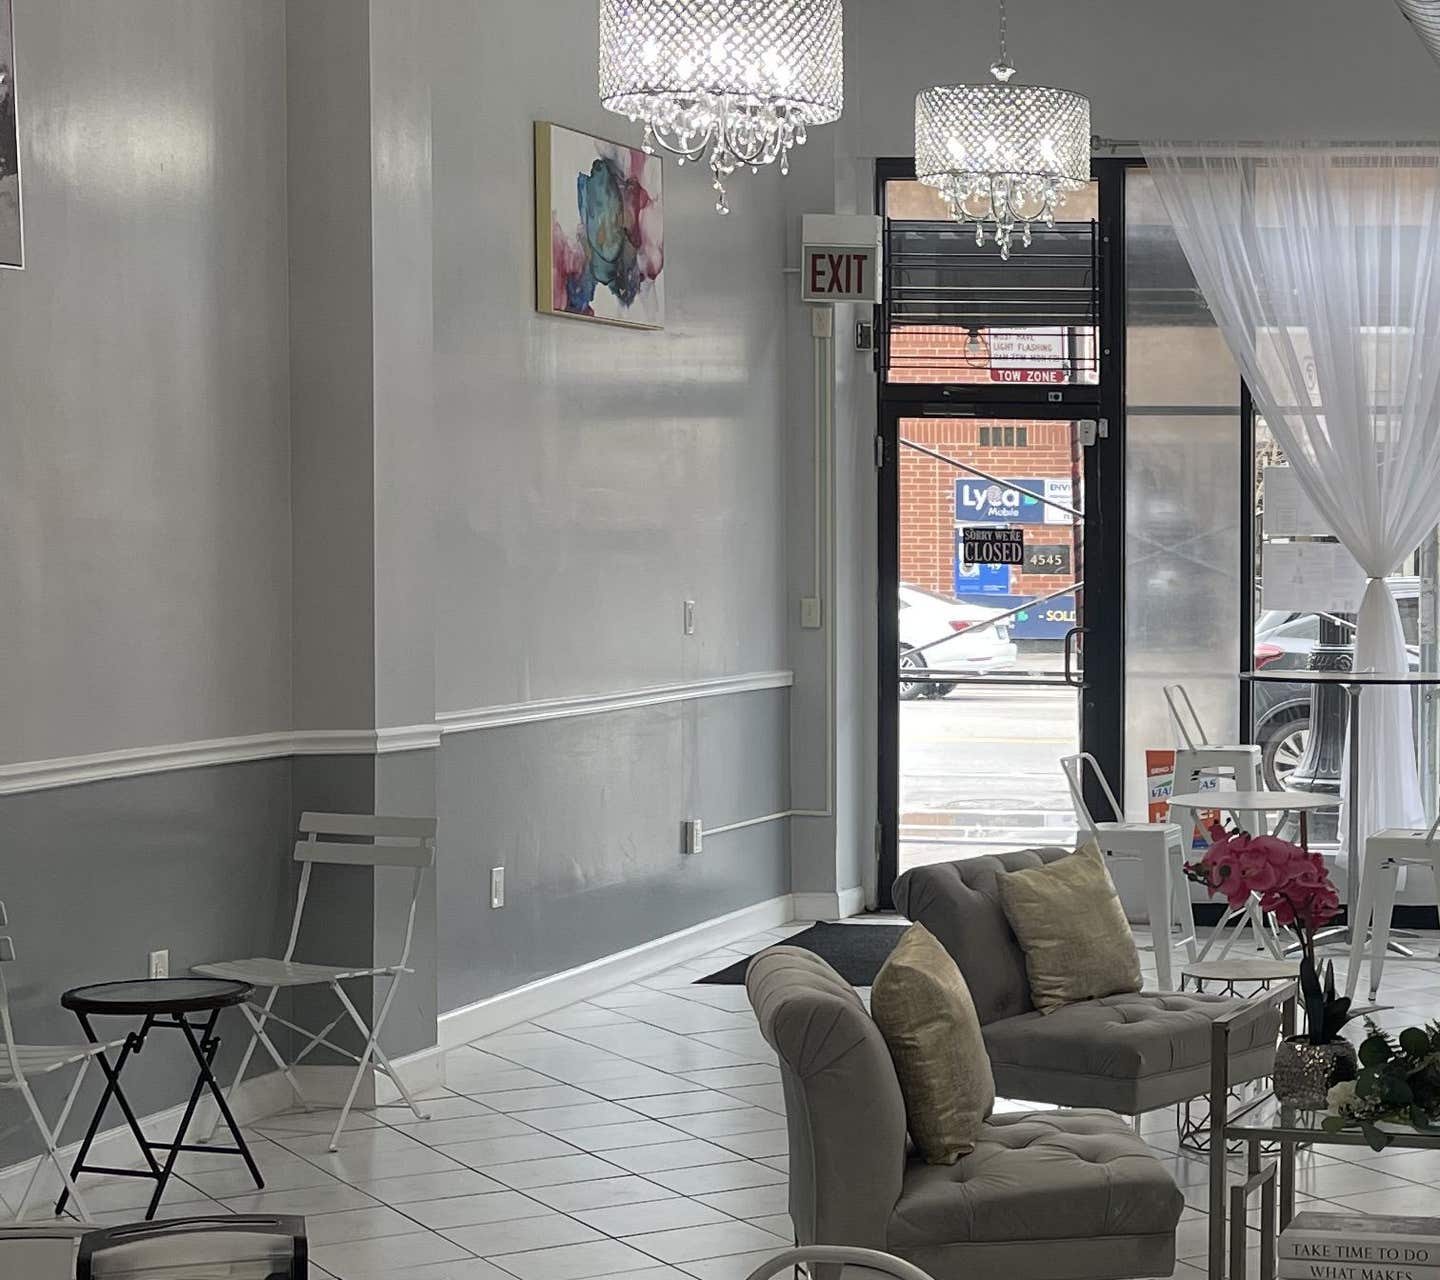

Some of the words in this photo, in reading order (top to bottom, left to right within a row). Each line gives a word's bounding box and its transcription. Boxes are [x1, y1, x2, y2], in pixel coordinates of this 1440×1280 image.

[812, 254, 867, 293] EXIT
[998, 371, 1021, 381] TOW
[1027, 371, 1057, 382] ZONE
[962, 484, 1020, 511] Lyca
[988, 507, 1020, 517] Mobile
[965, 530, 992, 541] SORRY
[965, 541, 1022, 561] CLOSED
[1030, 554, 1062, 566] 4545
[1292, 1243, 1331, 1257] TAKE
[1336, 1245, 1373, 1258] TIME
[1377, 1248, 1400, 1260] TO
[1404, 1249, 1429, 1262] DO
[1310, 1265, 1357, 1279] WHAT
